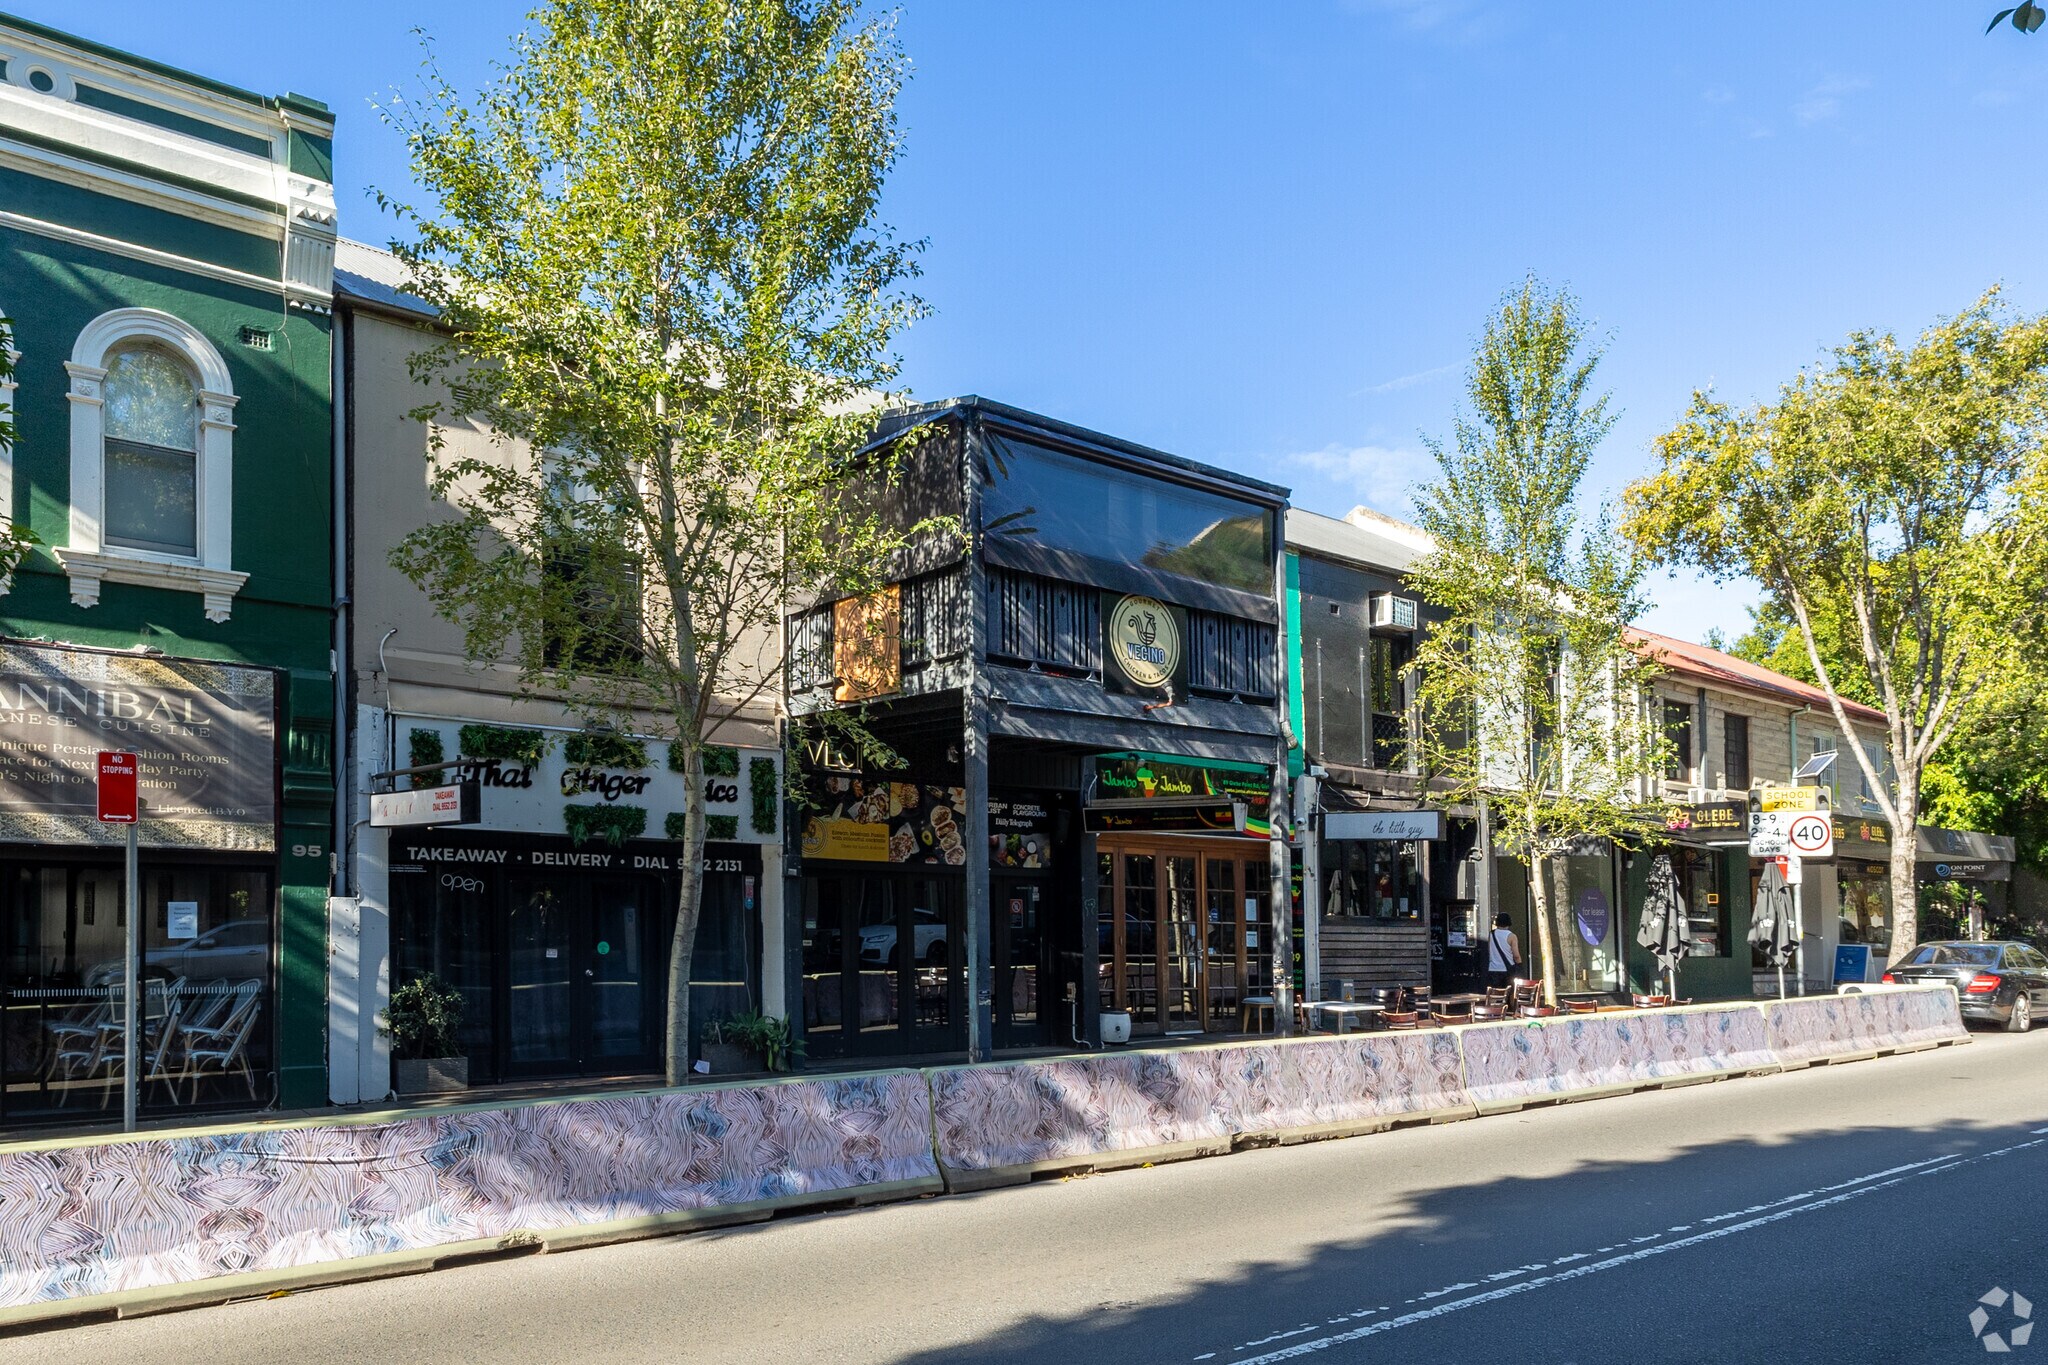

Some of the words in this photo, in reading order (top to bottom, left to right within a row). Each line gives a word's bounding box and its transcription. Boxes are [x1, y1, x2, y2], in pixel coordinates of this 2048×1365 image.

[1127, 642, 1165, 664] VECINO
[1124, 657, 1147, 679] CHICKEN
[1153, 666, 1169, 679] TACOS
[99, 719, 211, 738] CUISINE
[0, 740, 47, 752] nique
[181, 753, 229, 765] Rooms
[32, 756, 55, 767] for
[60, 758, 96, 770] Next
[112, 755, 123, 764] NO
[102, 765, 134, 775] STOPPING
[25, 772, 65, 784] Night
[71, 776, 86, 784] or
[464, 760, 533, 789] Thai
[684, 776, 738, 802] ice
[1103, 769, 1137, 788] Jambo
[1160, 775, 1192, 793] Jambo
[434, 790, 455, 800] TAKEAWAY
[1766, 791, 1812, 800] SCHOOL
[158, 804, 212, 815] Licenced
[432, 802, 441, 812] DIAL
[987, 802, 1008, 810] RBAN
[1013, 803, 1040, 812] CONCRETE
[1774, 801, 1804, 809] ZONE
[1696, 808, 1734, 822] GLEBE
[1009, 818, 1033, 828] Telegraph
[1372, 820, 1384, 834] the
[1388, 820, 1406, 834] little
[1406, 826, 1424, 839] guy
[1797, 825, 1823, 841] 40
[292, 844, 322, 857] 95
[407, 846, 508, 863] TAKEAWAY
[532, 852, 612, 867] DELIVERY
[634, 856, 669, 870] DIAL
[677, 858, 711, 872] 92
[715, 859, 742, 872] 2131
[441, 873, 485, 894] open
[1582, 907, 1591, 916] for
[1591, 907, 1605, 916] lease
